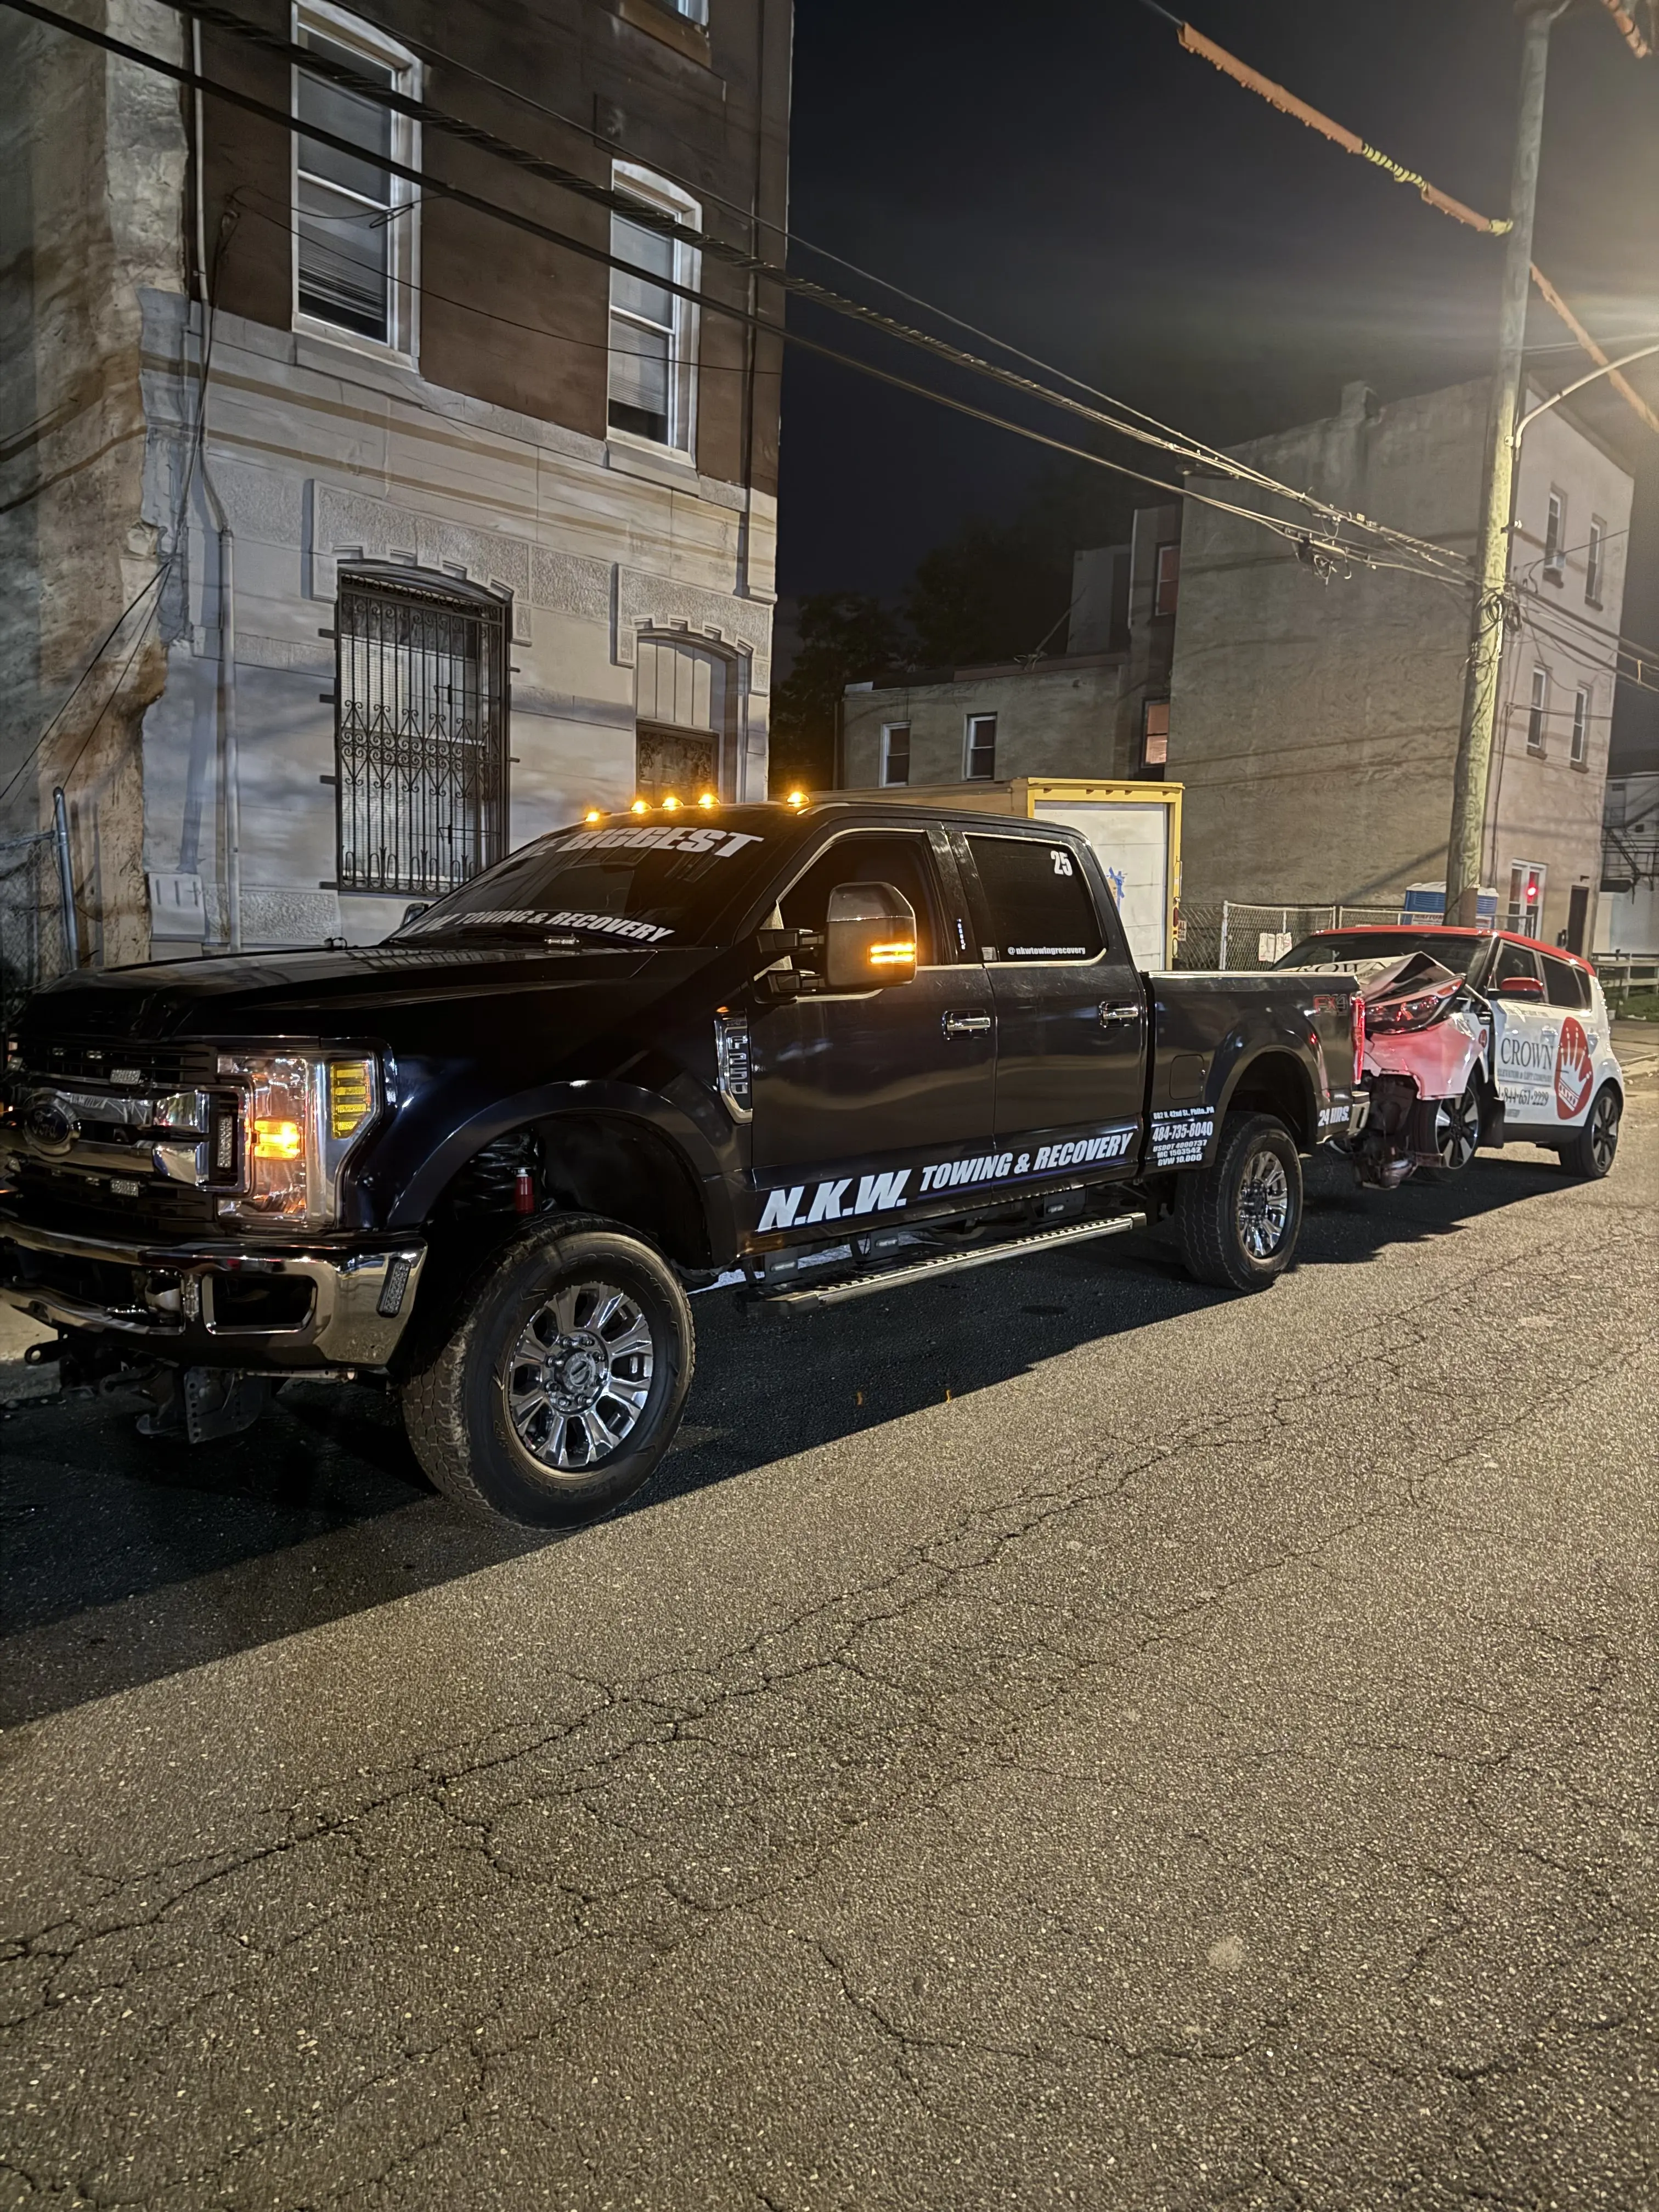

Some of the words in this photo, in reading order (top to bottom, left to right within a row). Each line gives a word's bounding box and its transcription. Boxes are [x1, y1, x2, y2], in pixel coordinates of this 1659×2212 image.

[555, 827, 765, 857] BIGGEST
[1050, 850, 1073, 877] 25
[454, 910, 535, 925] TOWING
[526, 912, 549, 924] &
[544, 912, 675, 943] RECOVERY
[1313, 994, 1348, 1015] FX4
[1500, 1037, 1554, 1070] CROWN
[1169, 1109, 1182, 1118] 42nd
[1318, 1108, 1330, 1127] 24
[1152, 1121, 1214, 1142] 484-735-8040
[1153, 1143, 1176, 1153] USDOT
[1175, 1139, 1207, 1149] 4000737
[1157, 1150, 1168, 1159] MC
[1169, 1147, 1202, 1156] 1503542
[1158, 1156, 1175, 1167] GVW
[757, 1169, 912, 1233] N.K.W.
[919, 1152, 1014, 1192] TOWING
[1014, 1153, 1031, 1175] &
[1032, 1132, 1135, 1171] RECOVERY
